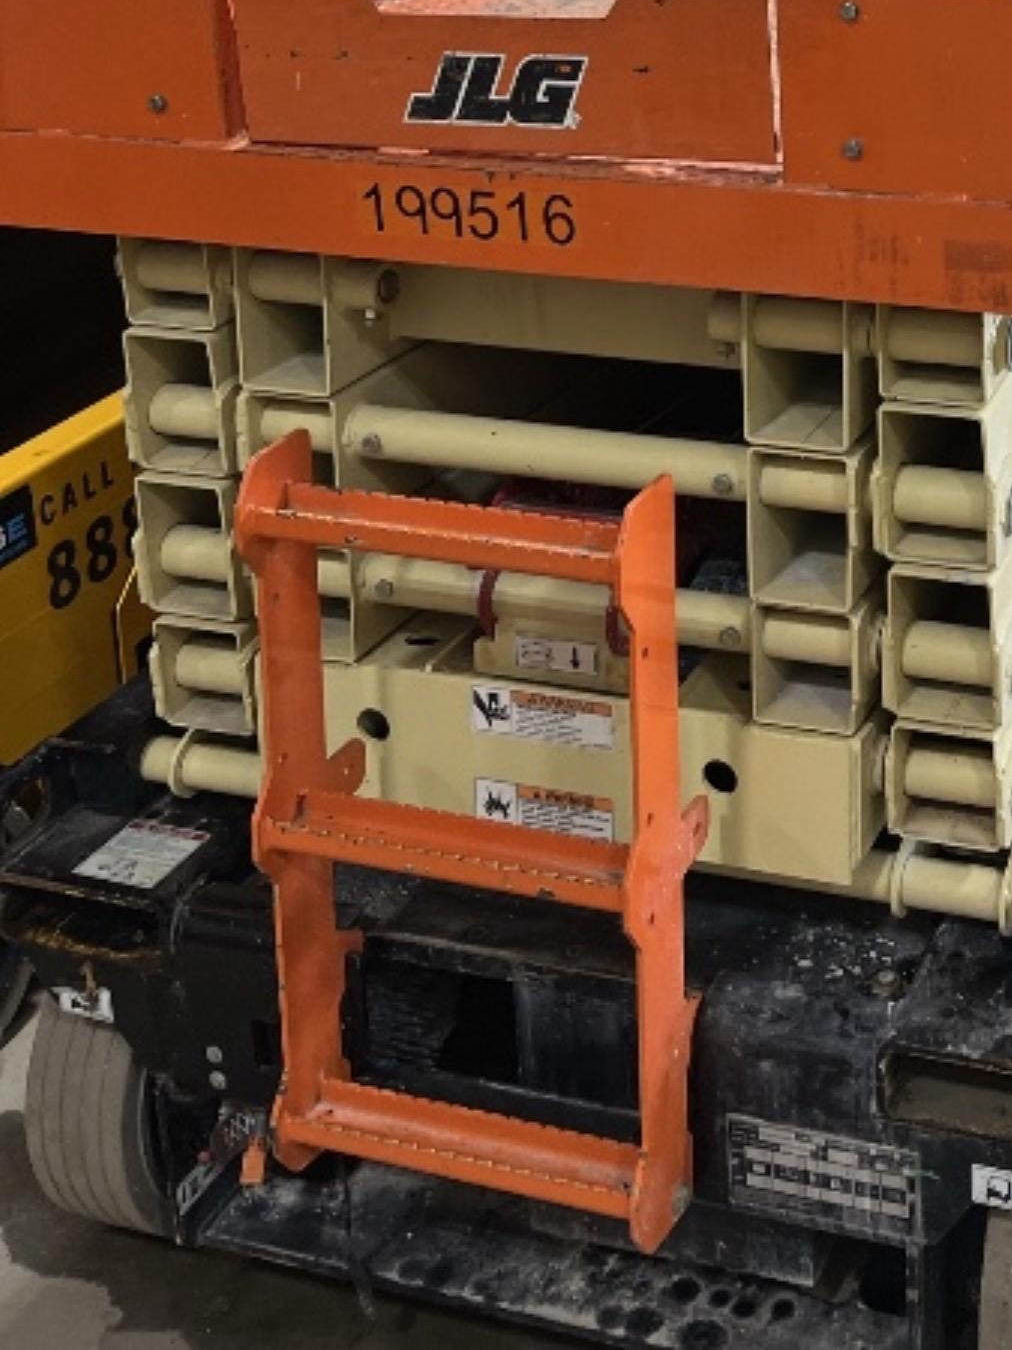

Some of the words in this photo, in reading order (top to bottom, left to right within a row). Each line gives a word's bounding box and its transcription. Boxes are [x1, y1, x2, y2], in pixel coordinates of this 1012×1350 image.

[403, 50, 589, 129] JLG
[363, 182, 576, 247] 199516
[40, 461, 115, 526] CALL
